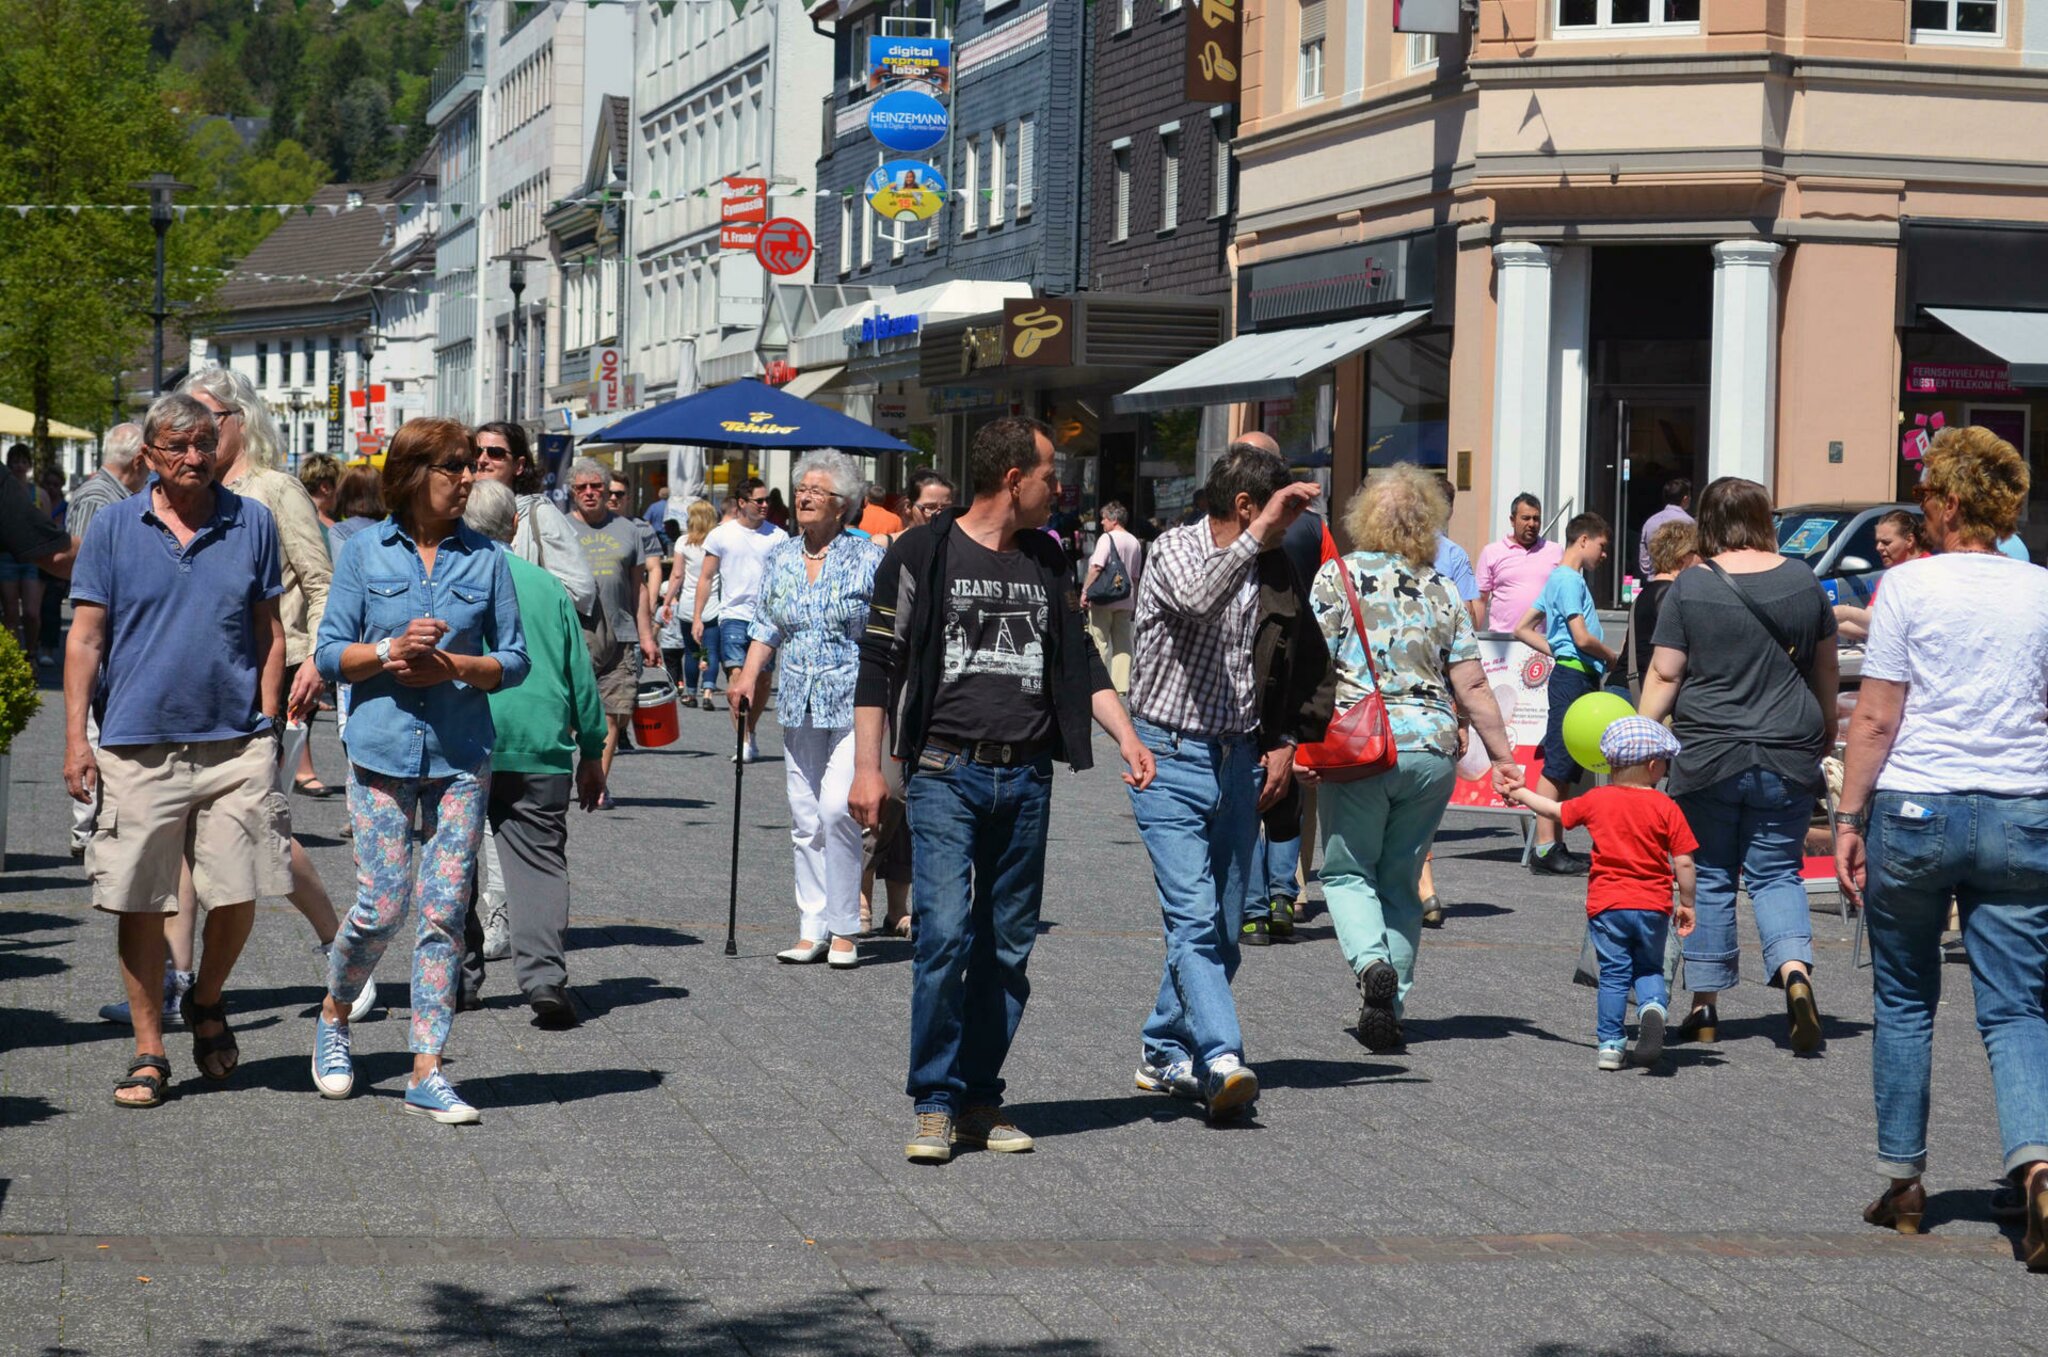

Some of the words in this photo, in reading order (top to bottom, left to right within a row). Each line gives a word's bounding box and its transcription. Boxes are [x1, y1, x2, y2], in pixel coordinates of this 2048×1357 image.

[888, 45, 933, 57] digital
[882, 57, 939, 67] express
[892, 65, 929, 75] labor
[870, 112, 947, 125] HEINZEMANN
[1912, 367, 1995, 379] FERNSEHVIELFALT
[1912, 377, 1947, 388] BESTEN
[1951, 379, 1993, 390] TELEKOM
[720, 421, 800, 434] Tchibo
[950, 579, 1002, 598] JEANS
